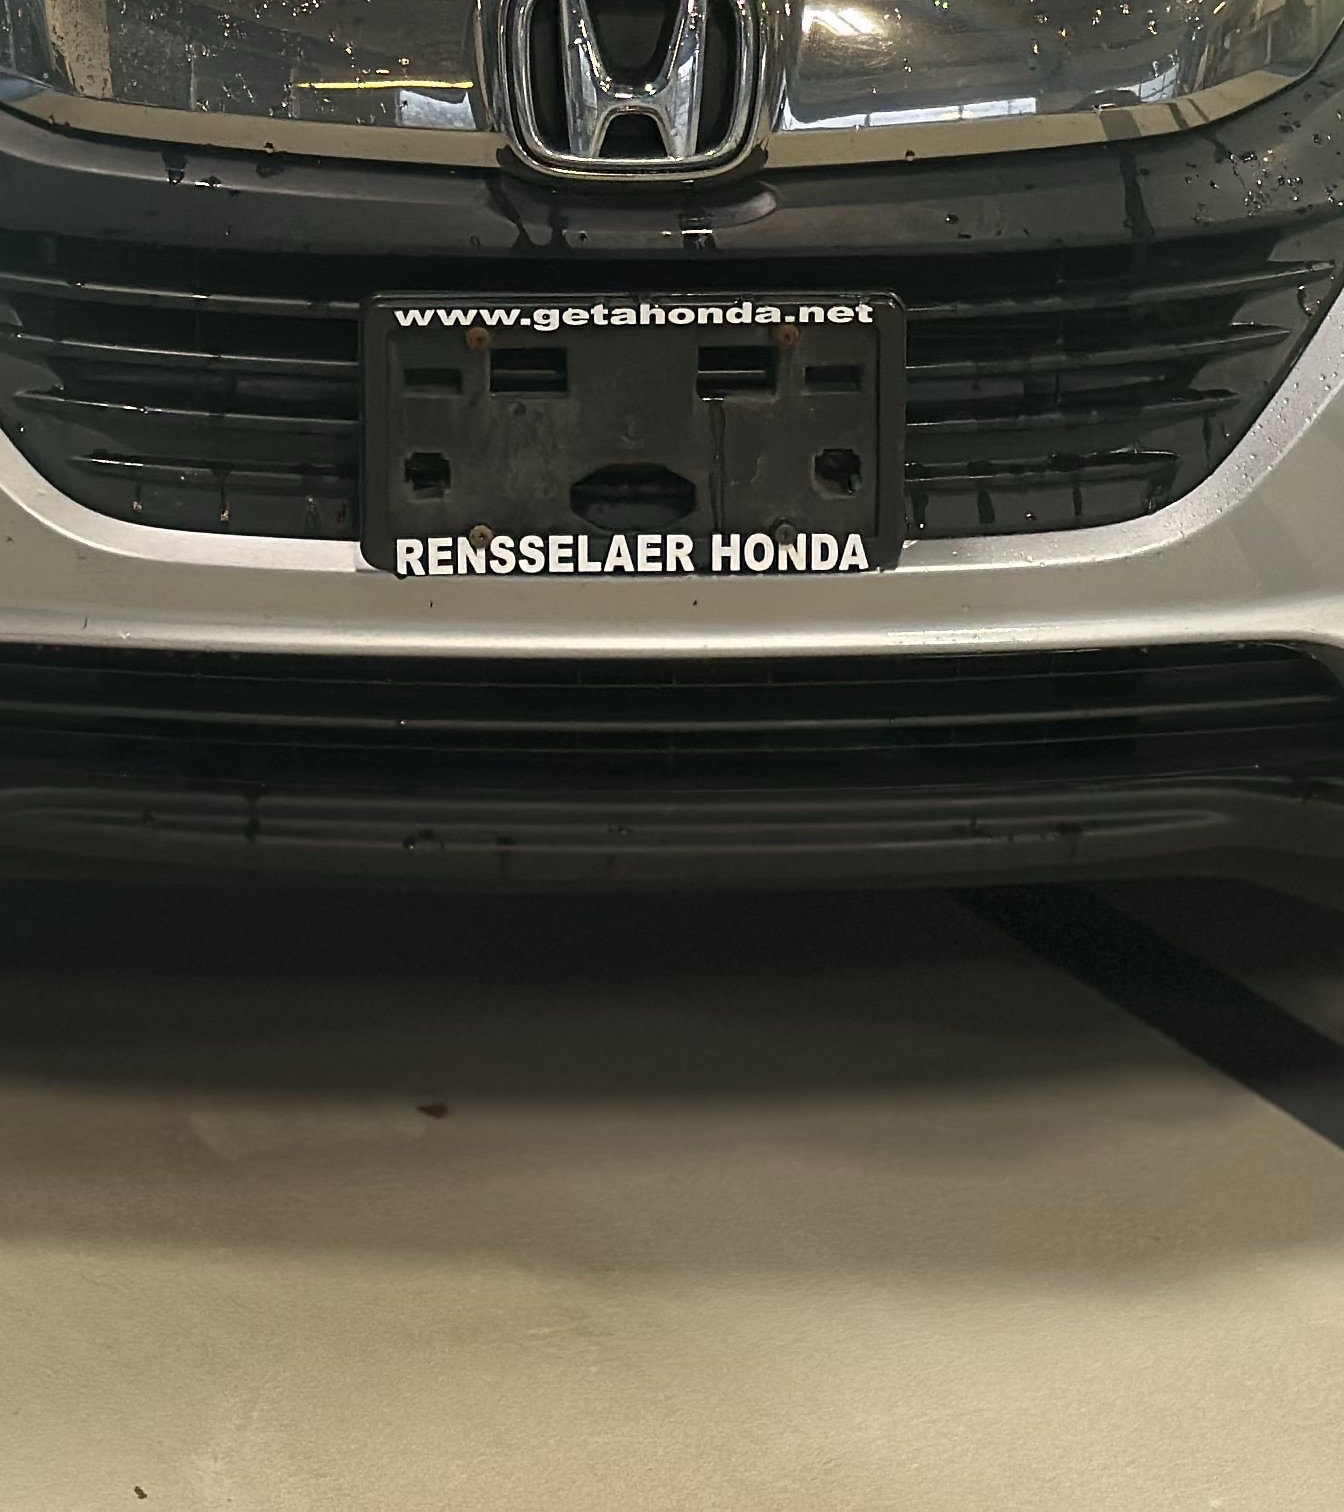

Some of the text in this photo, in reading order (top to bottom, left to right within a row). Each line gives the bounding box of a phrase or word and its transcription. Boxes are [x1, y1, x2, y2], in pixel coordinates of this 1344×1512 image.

[395, 302, 873, 331] www.getahonda.net
[396, 533, 869, 574] RENSSELAER HONDA
